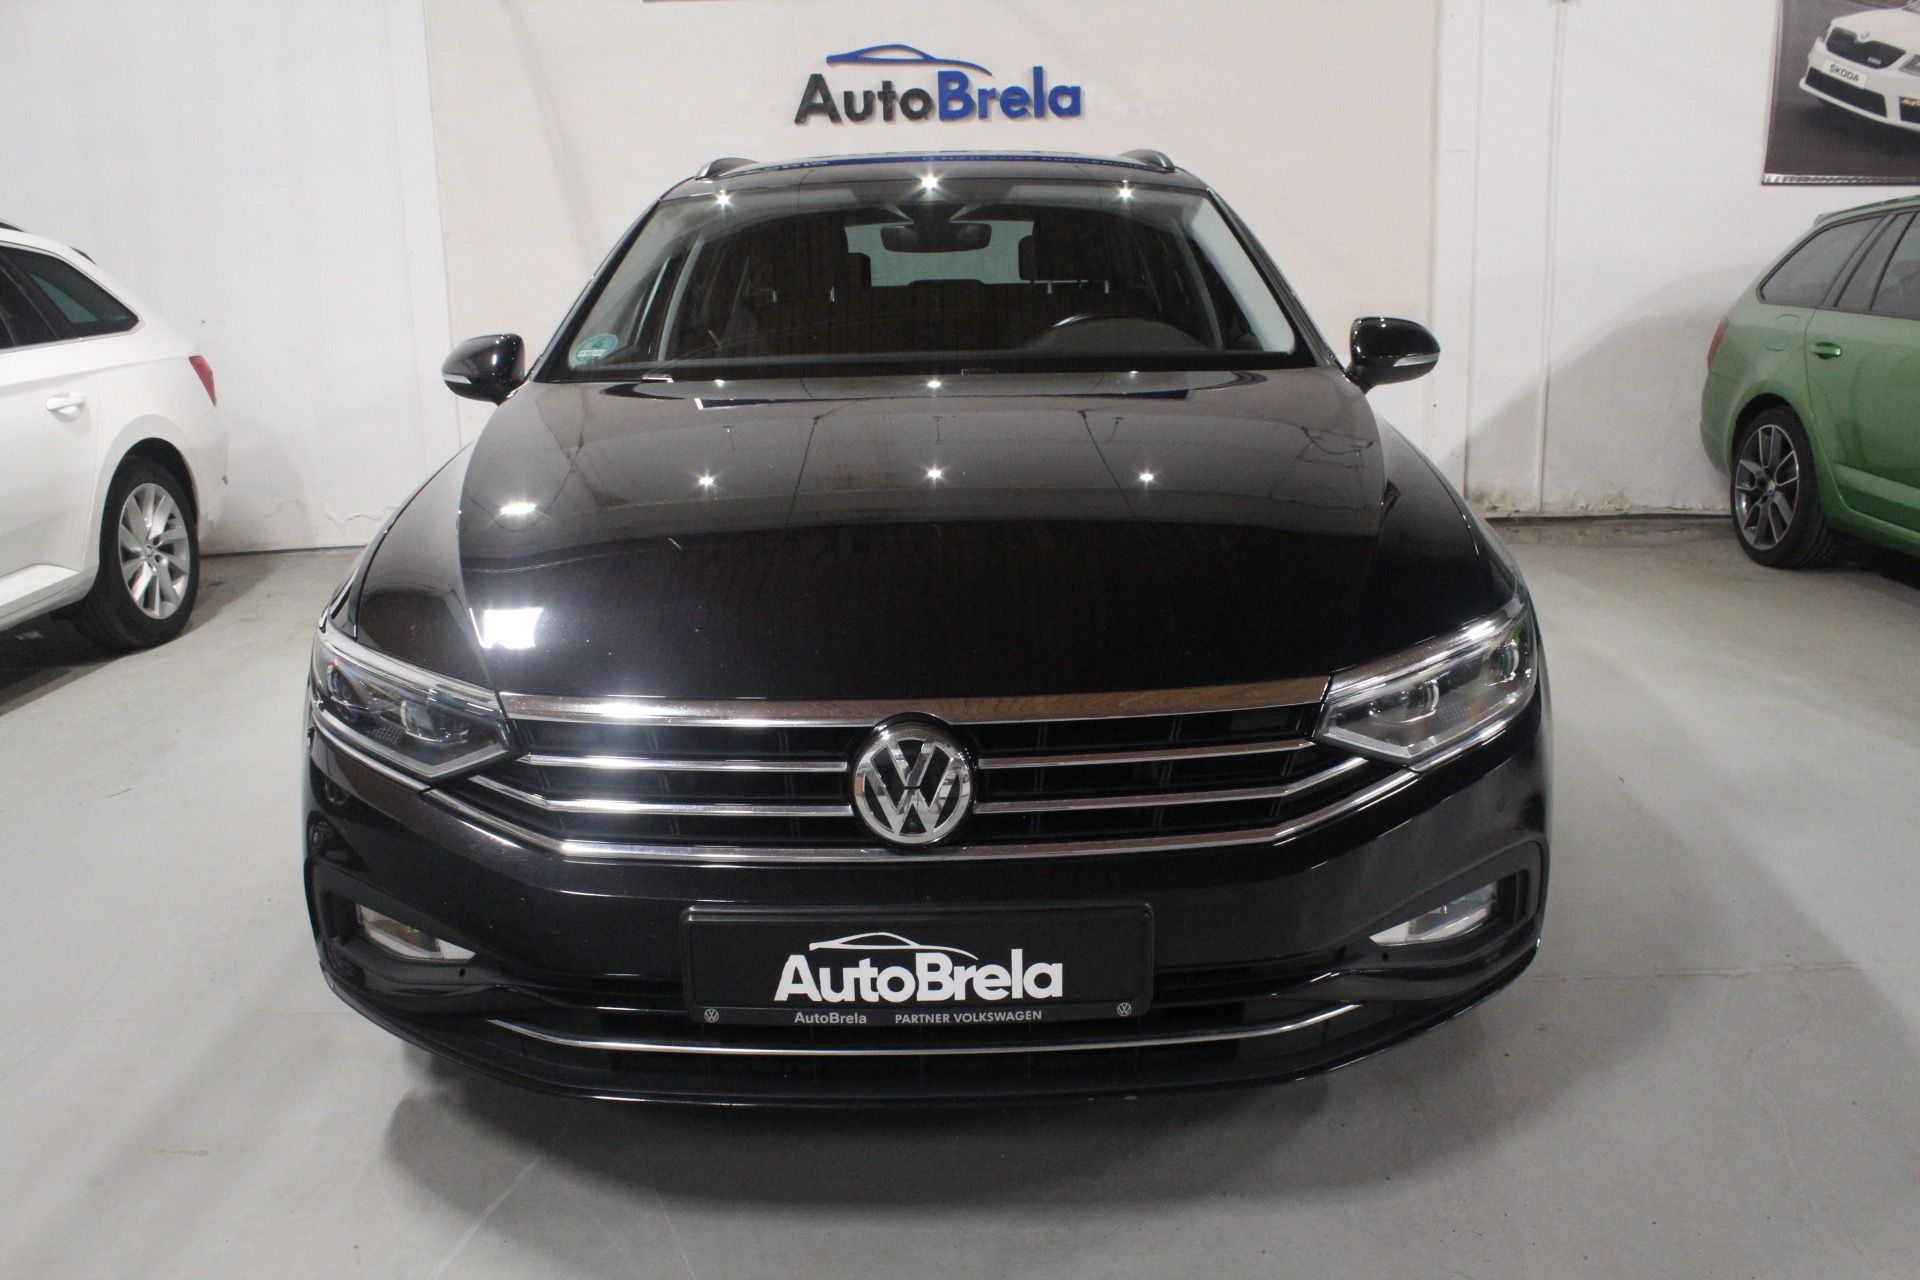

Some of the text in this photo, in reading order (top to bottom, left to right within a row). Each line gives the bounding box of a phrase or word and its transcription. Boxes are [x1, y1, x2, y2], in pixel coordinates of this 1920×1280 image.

[794, 66, 1081, 124] AutoBrela
[774, 949, 1063, 1003] AutoBrela
[794, 1010, 1042, 1024] AutoBrela PARTNER VOLKSWAGEN
